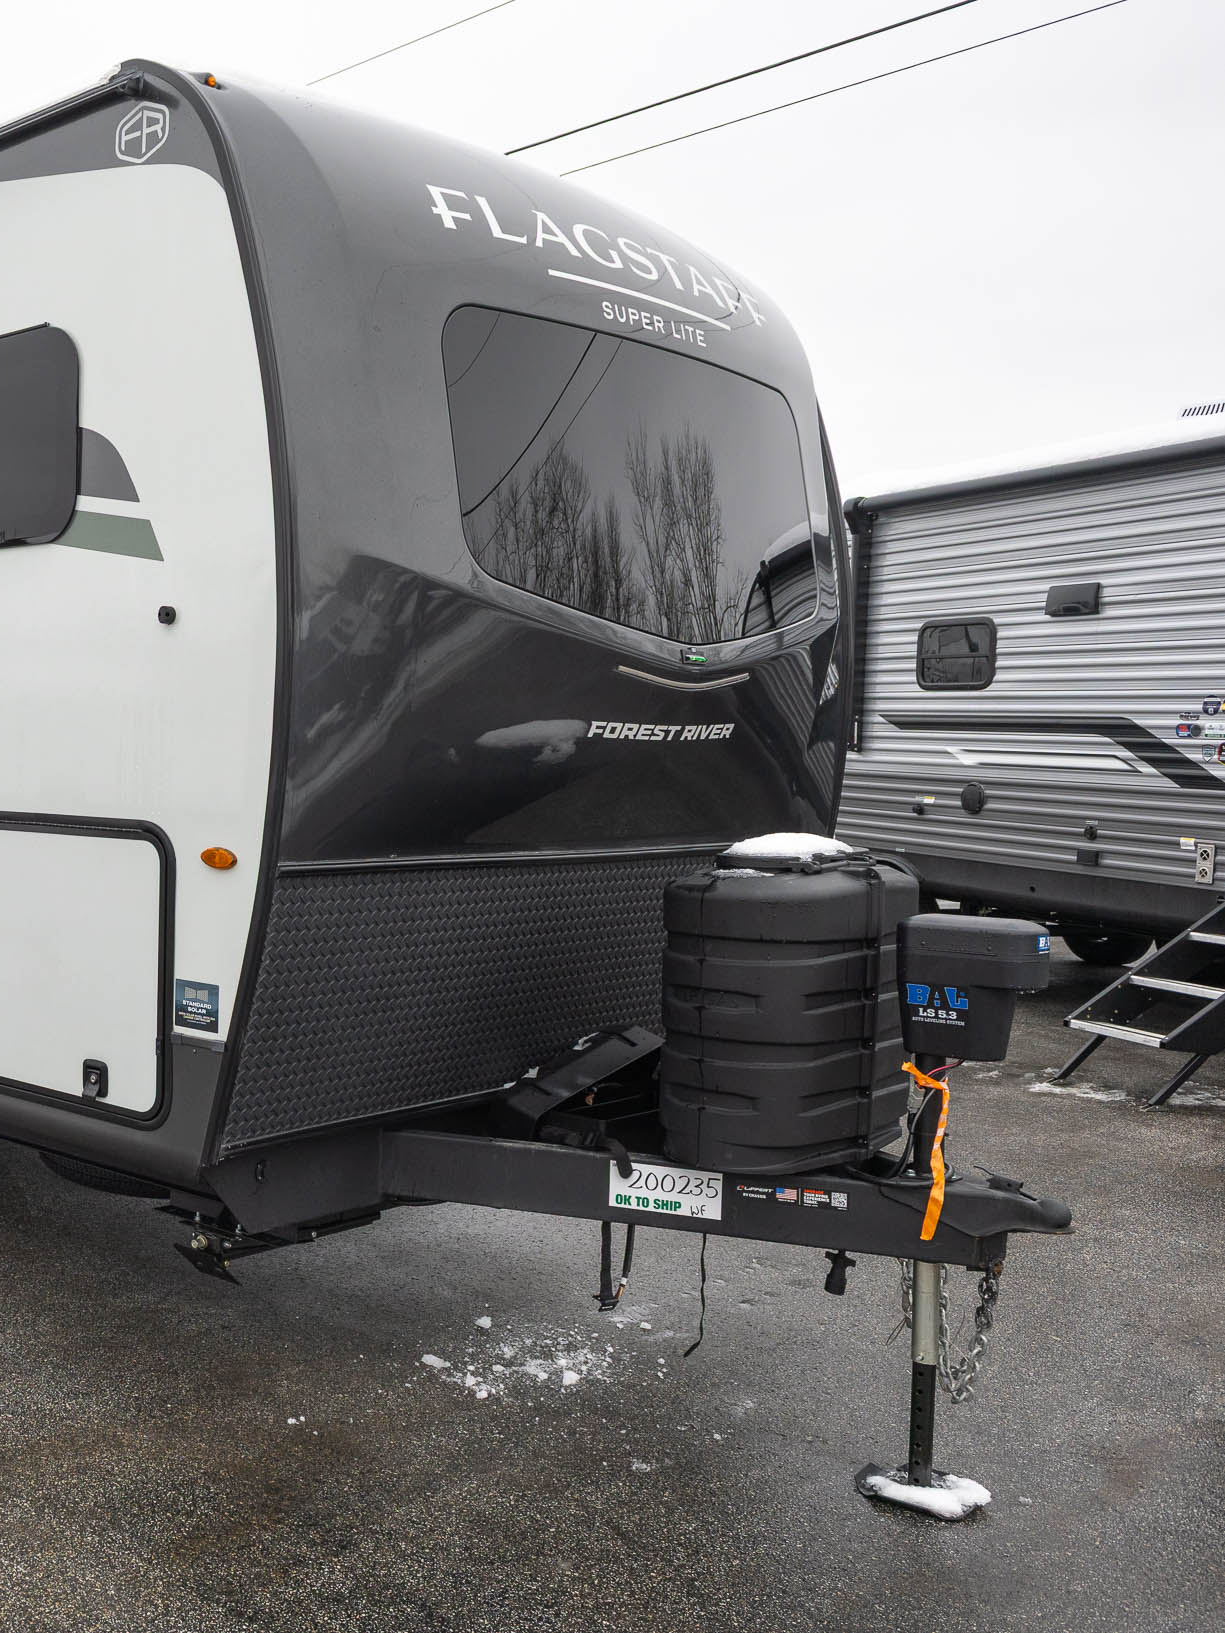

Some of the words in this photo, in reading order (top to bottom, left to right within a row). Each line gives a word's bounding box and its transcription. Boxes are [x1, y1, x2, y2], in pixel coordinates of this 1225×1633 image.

[426, 184, 766, 327] FLAGSTAFF
[602, 301, 666, 335] SUPER
[671, 320, 707, 348] LITE
[587, 720, 681, 741] FOREST
[679, 723, 736, 741] RIVER
[182, 1000, 211, 1009] STANDARD
[187, 1006, 206, 1014] SOLAR
[918, 1007, 936, 1017] LS
[938, 1009, 957, 1020] 5.3
[628, 1168, 721, 1199] 200235
[615, 1193, 632, 1206] OK
[635, 1196, 650, 1208] TO
[653, 1198, 682, 1212] SHIP
